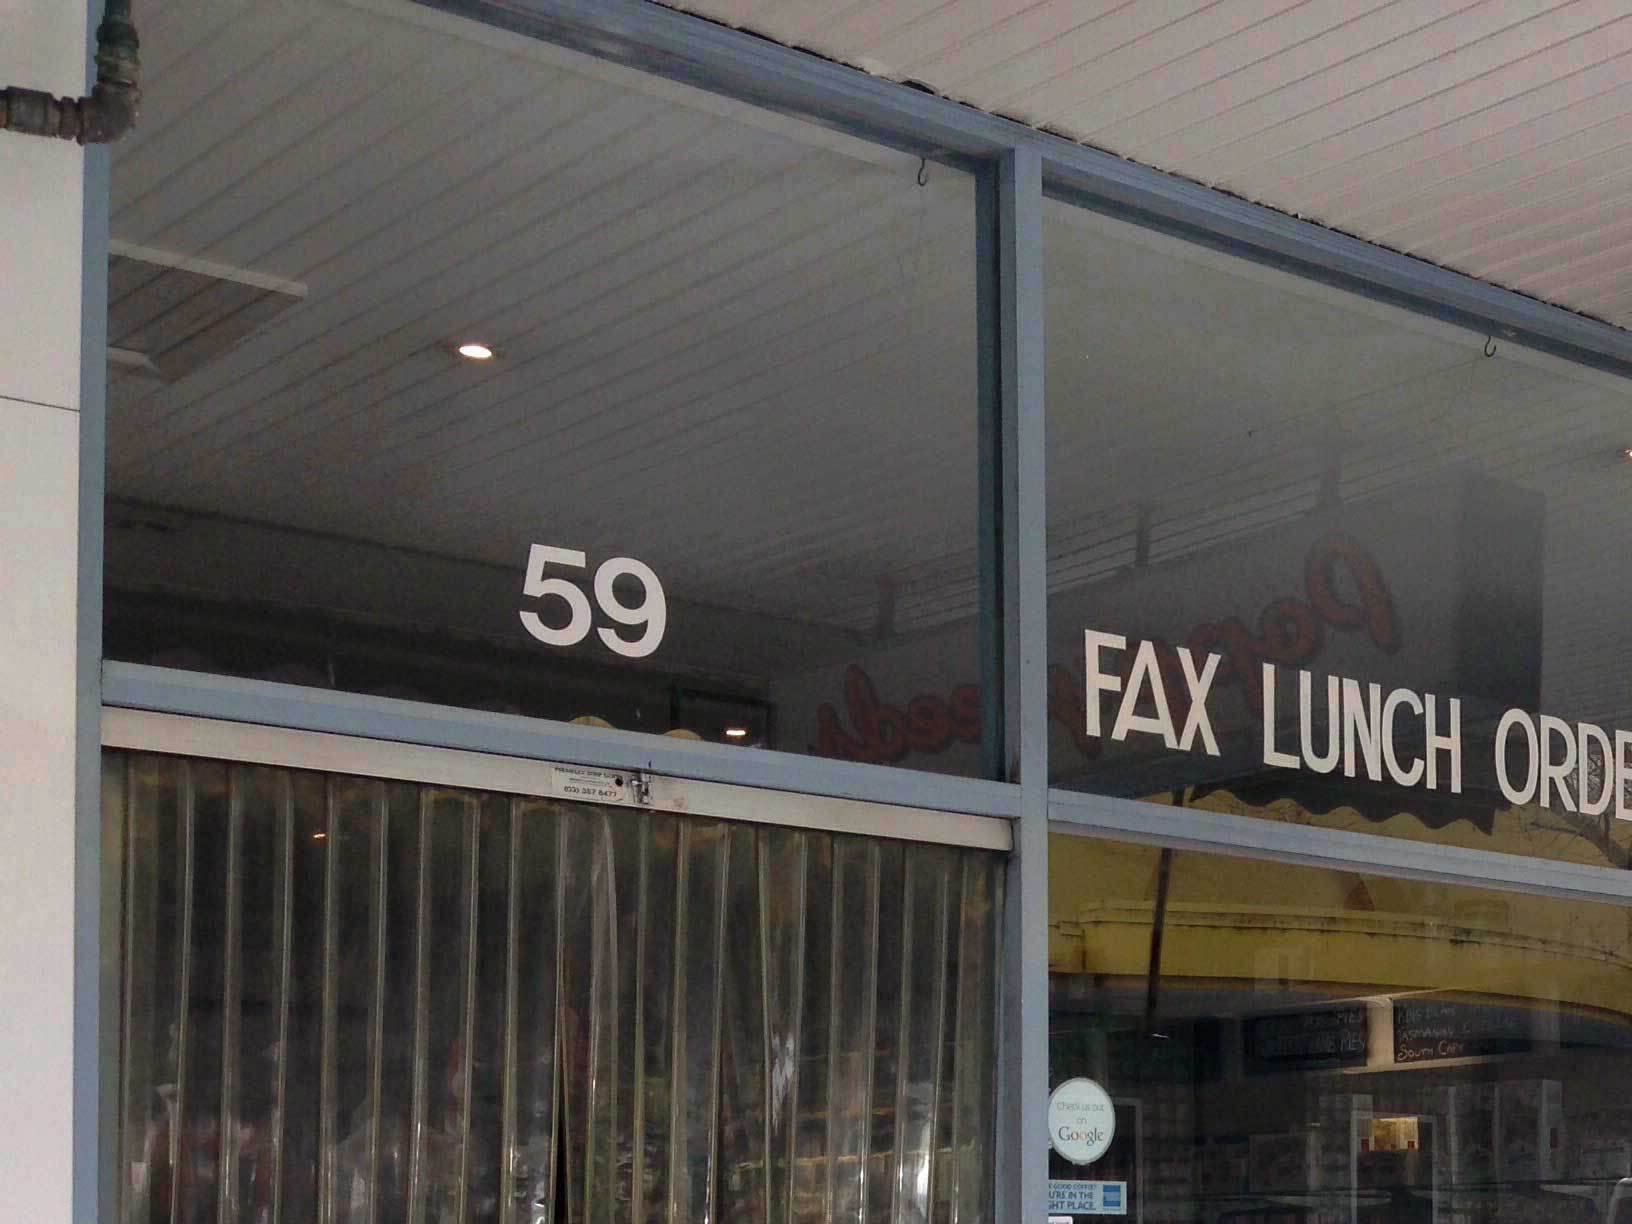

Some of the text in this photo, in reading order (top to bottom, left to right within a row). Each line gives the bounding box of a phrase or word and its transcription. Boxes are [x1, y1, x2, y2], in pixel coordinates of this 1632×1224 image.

[519, 543, 667, 658] 59
[1085, 629, 1221, 756] FAX
[1262, 663, 1462, 794] LUNCH
[1076, 1117, 1087, 1125] on
[1058, 1126, 1104, 1147] Google
[1067, 1190, 1077, 1200] IN
[1079, 1190, 1094, 1200] THE
